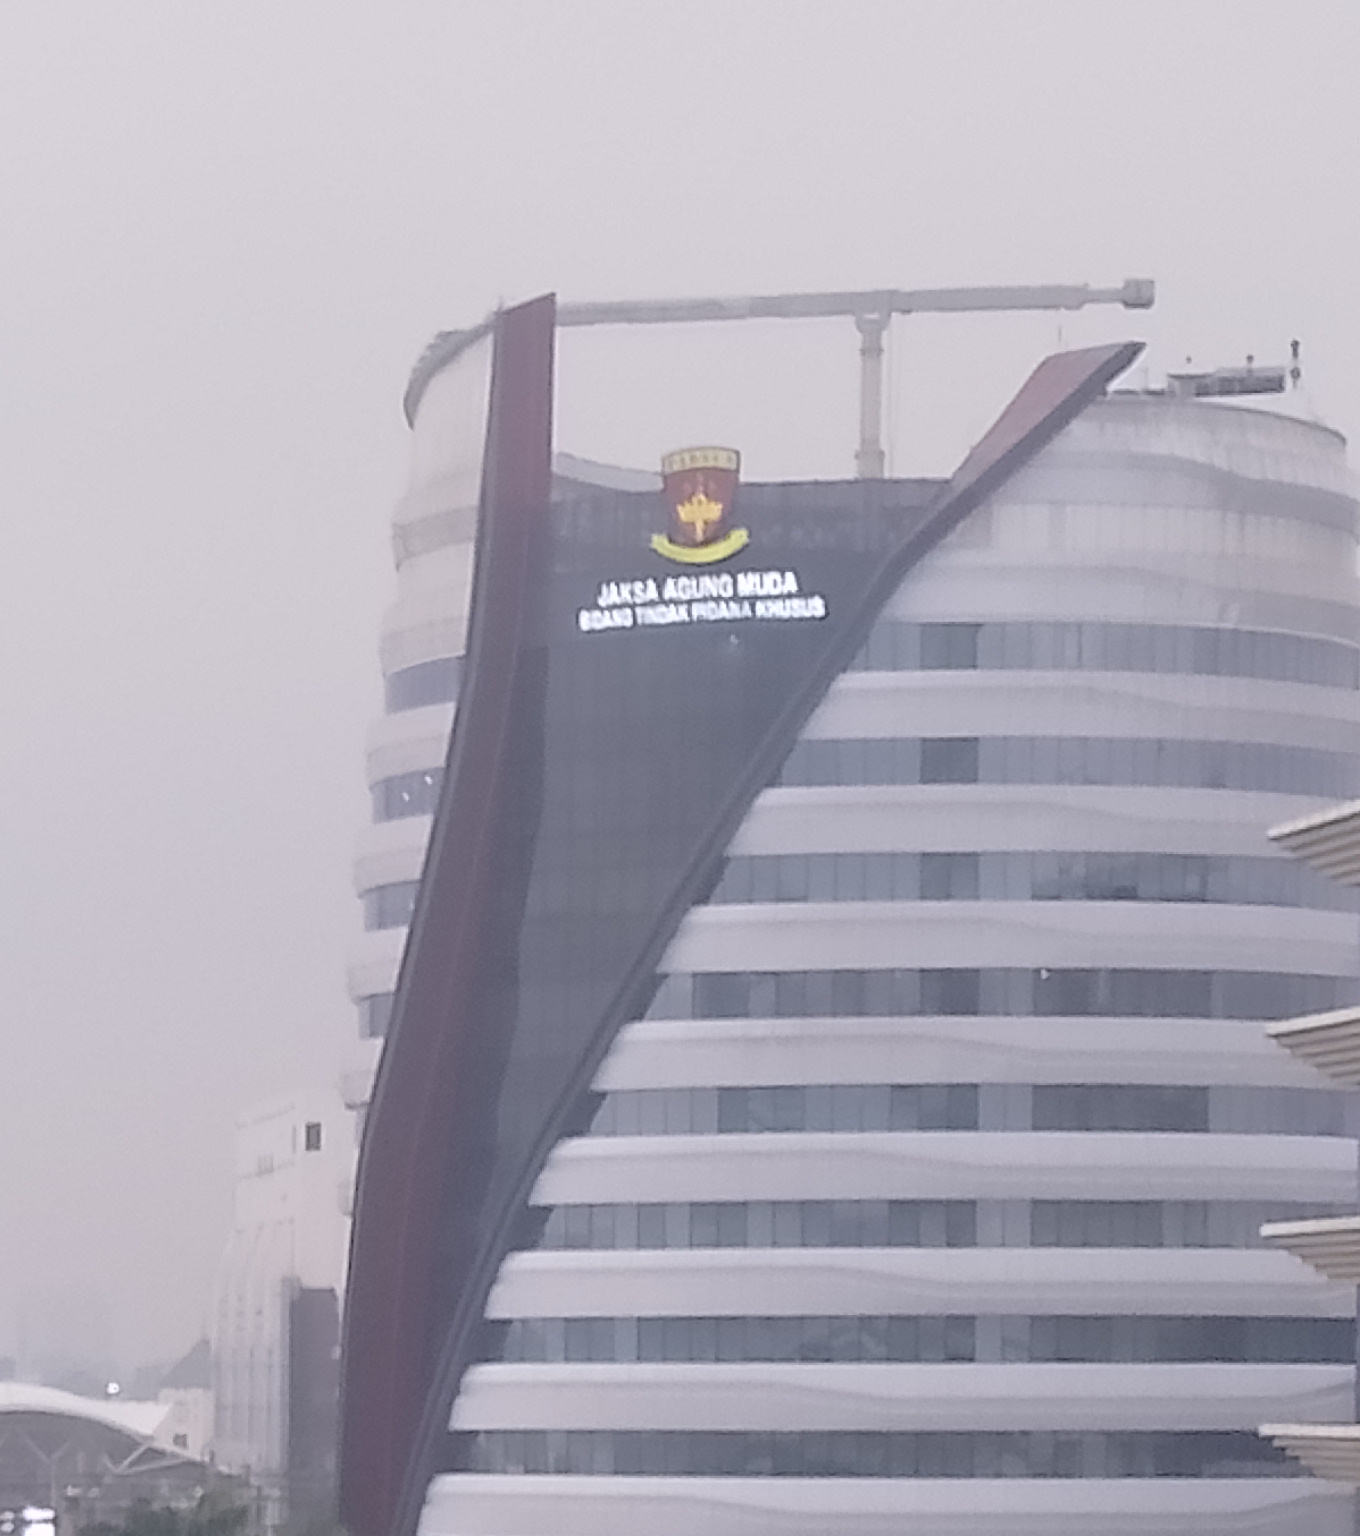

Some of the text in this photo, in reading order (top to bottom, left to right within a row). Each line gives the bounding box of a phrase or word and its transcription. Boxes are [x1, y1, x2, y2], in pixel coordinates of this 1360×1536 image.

[597, 571, 799, 608] JAKSA AGUNG MUDA
[755, 595, 826, 618] KHUSUS
